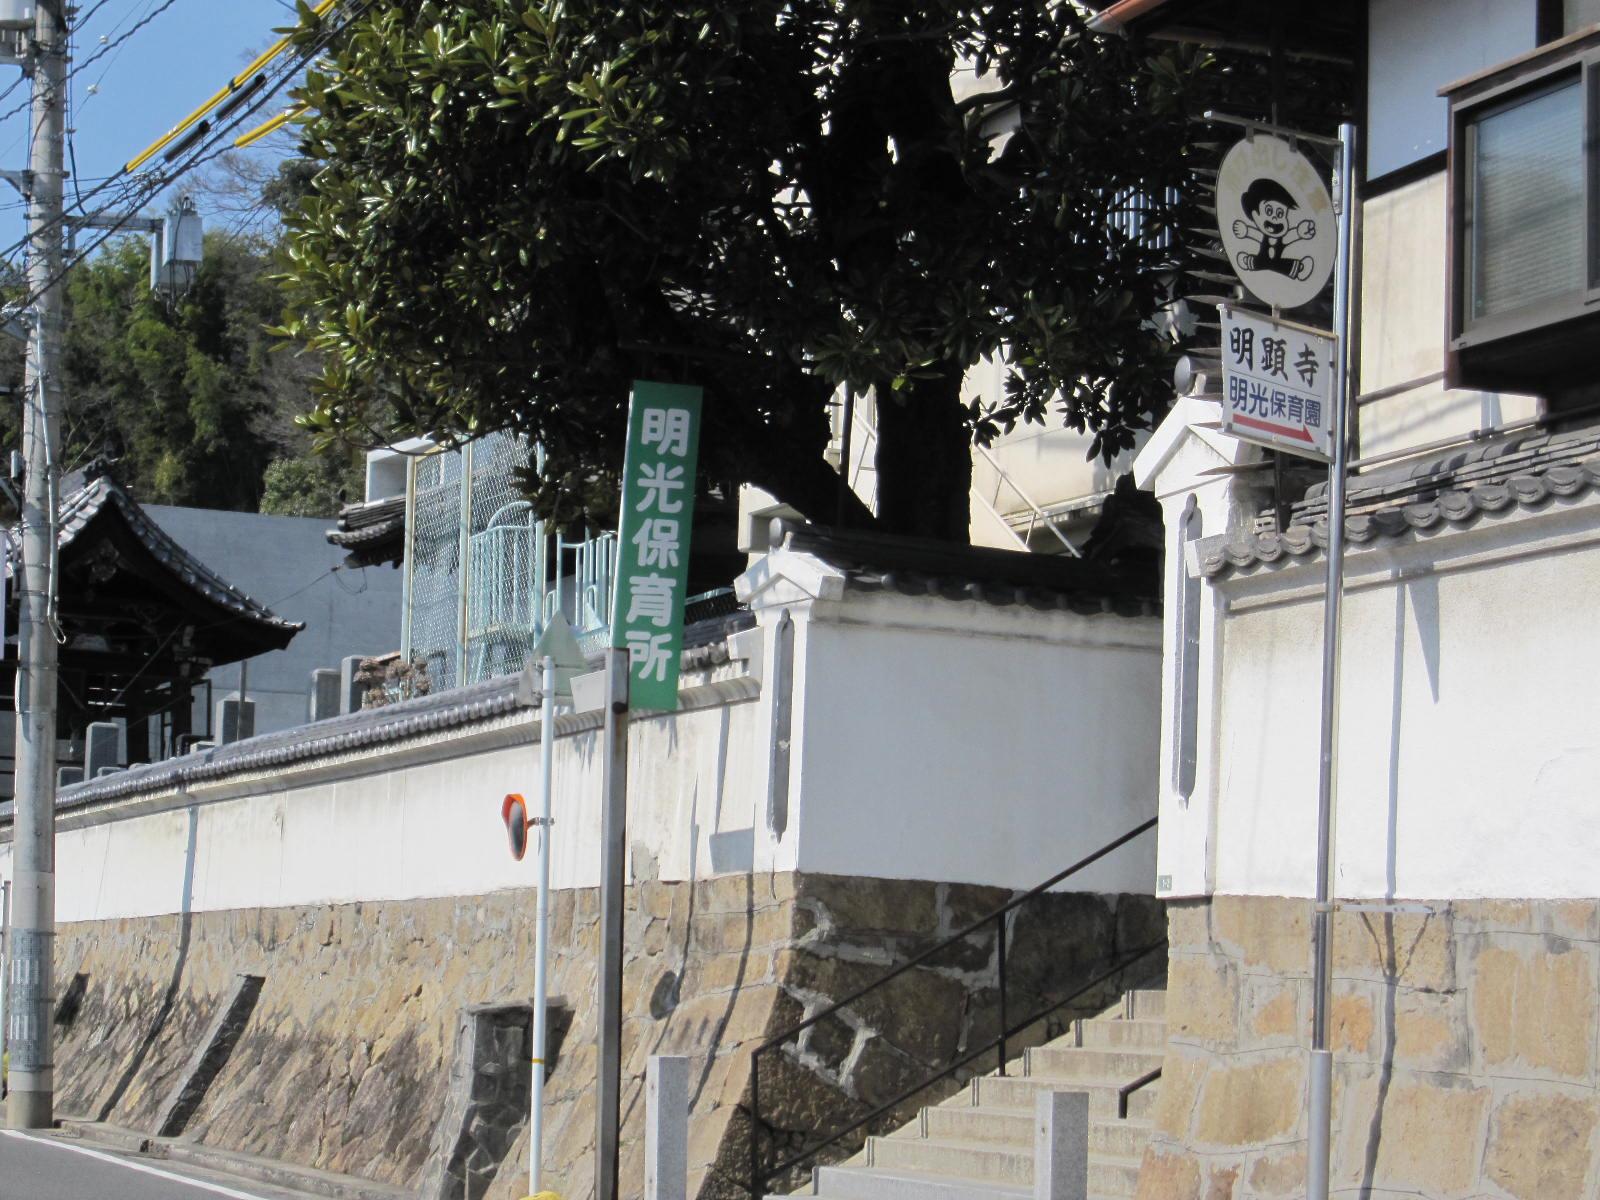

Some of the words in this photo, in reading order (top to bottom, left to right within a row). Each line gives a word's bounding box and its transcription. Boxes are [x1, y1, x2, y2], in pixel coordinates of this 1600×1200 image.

[1229, 327, 1319, 388] 明顕寺
[1229, 375, 1321, 428] 明光保育園
[625, 408, 691, 682] 明光保育所
